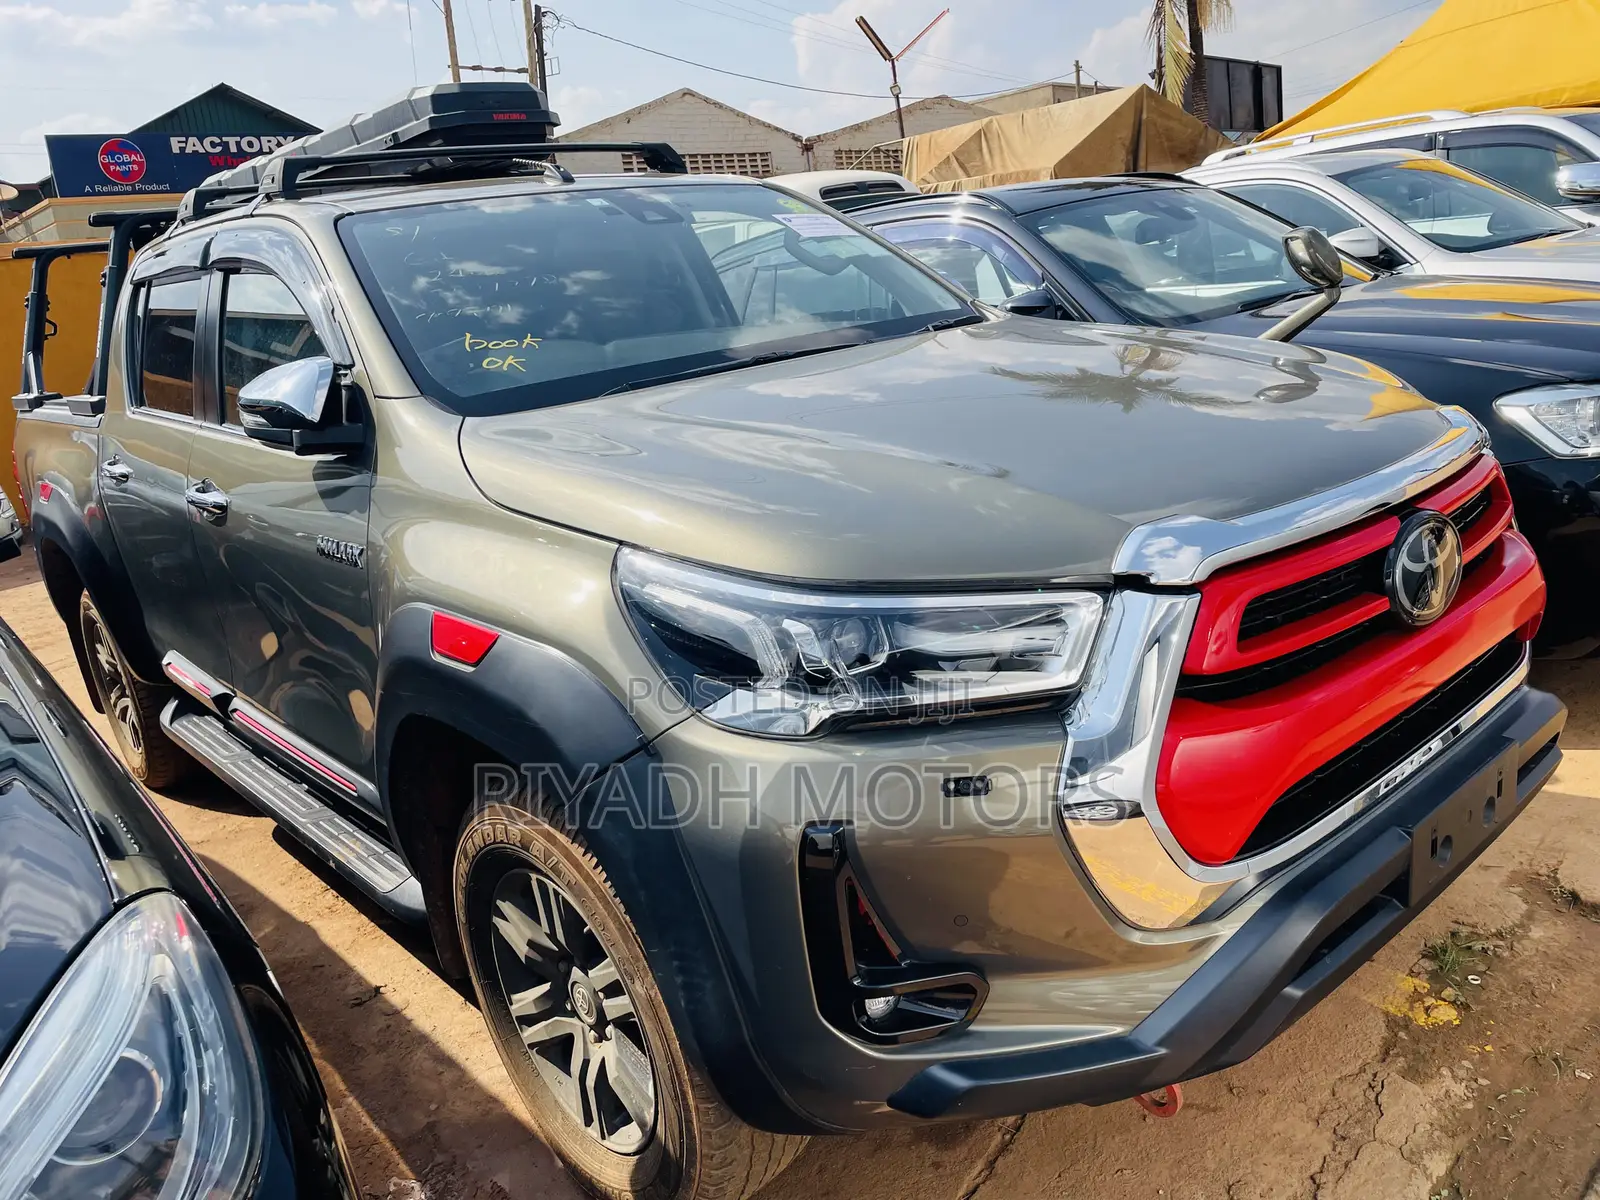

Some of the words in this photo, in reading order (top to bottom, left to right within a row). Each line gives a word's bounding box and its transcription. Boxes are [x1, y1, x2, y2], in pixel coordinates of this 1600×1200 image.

[170, 136, 294, 153] FACTORY
[100, 153, 144, 163] GLOBAL
[110, 164, 138, 172] PAINTS
[95, 184, 132, 192] Reliable
[135, 182, 170, 191] Product
